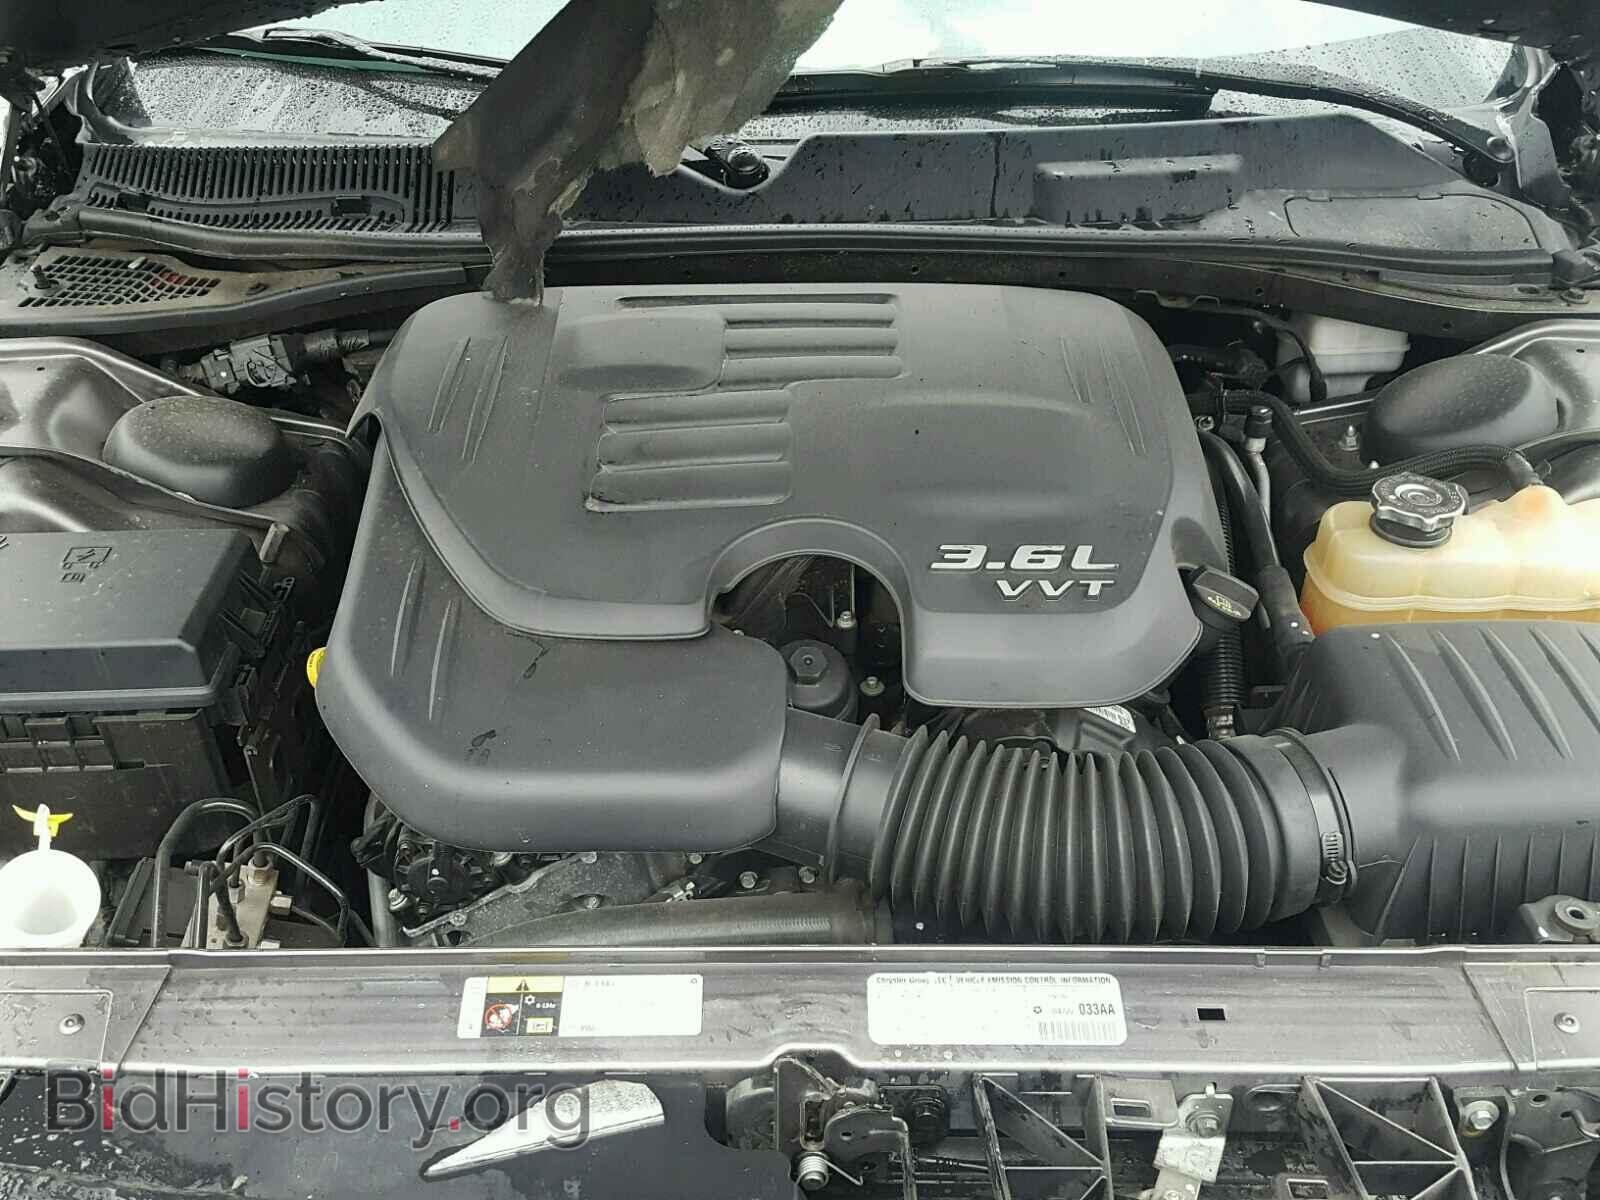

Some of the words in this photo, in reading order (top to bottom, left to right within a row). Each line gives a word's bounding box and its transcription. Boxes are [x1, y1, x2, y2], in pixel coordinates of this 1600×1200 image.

[929, 544, 1120, 571] 3.6L
[995, 579, 1115, 602] VVT
[1024, 976, 1057, 984] CONTROL
[1078, 1002, 1116, 1016] 033AA
